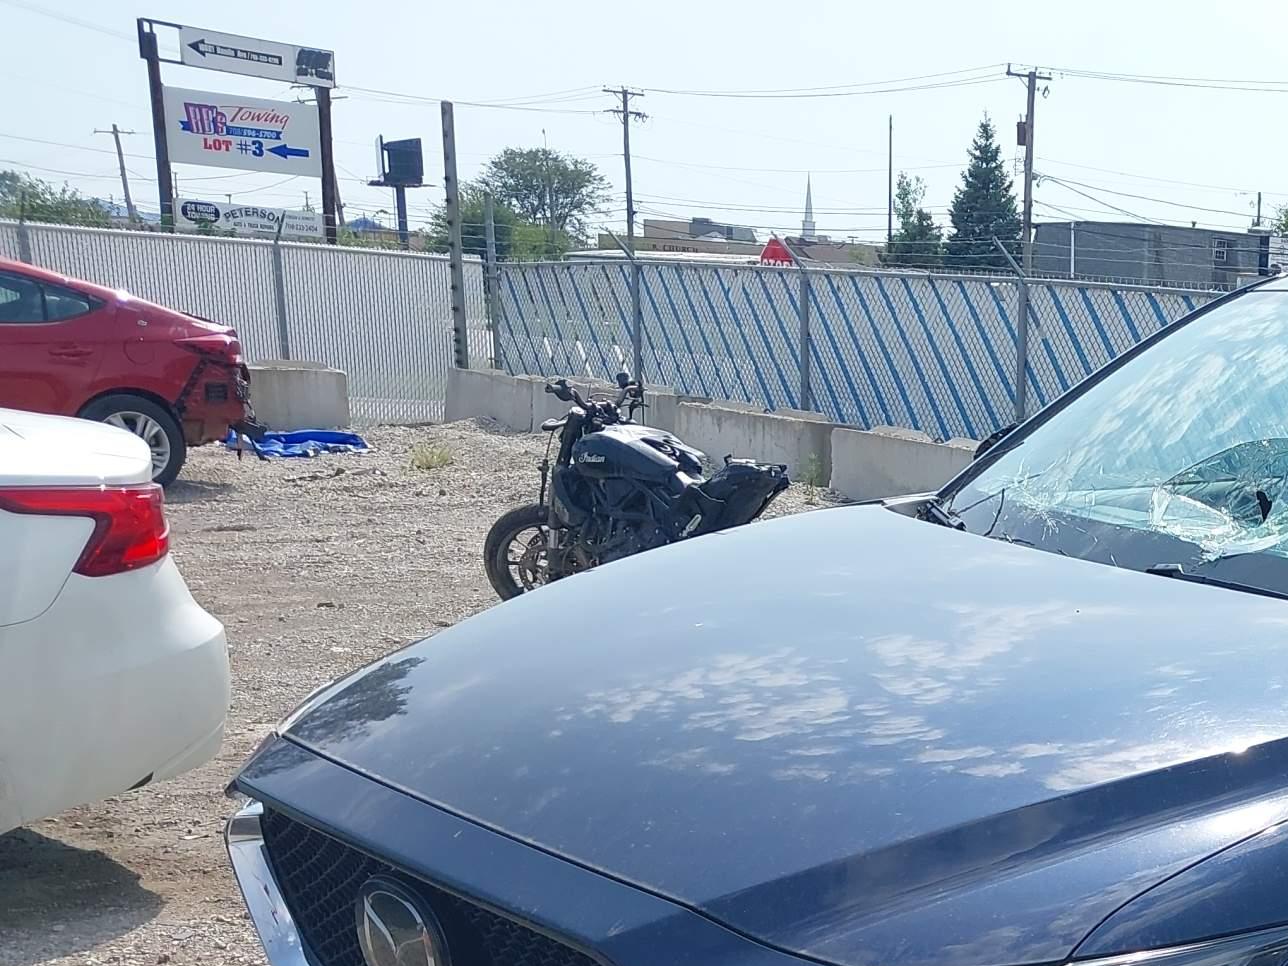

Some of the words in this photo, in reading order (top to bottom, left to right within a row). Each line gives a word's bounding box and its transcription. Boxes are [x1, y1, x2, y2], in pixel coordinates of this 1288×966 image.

[219, 105, 290, 130] Towing
[203, 138, 232, 152] LOT
[236, 139, 264, 157] #3
[197, 204, 216, 213] HOUR
[223, 207, 281, 225] PETERSON
